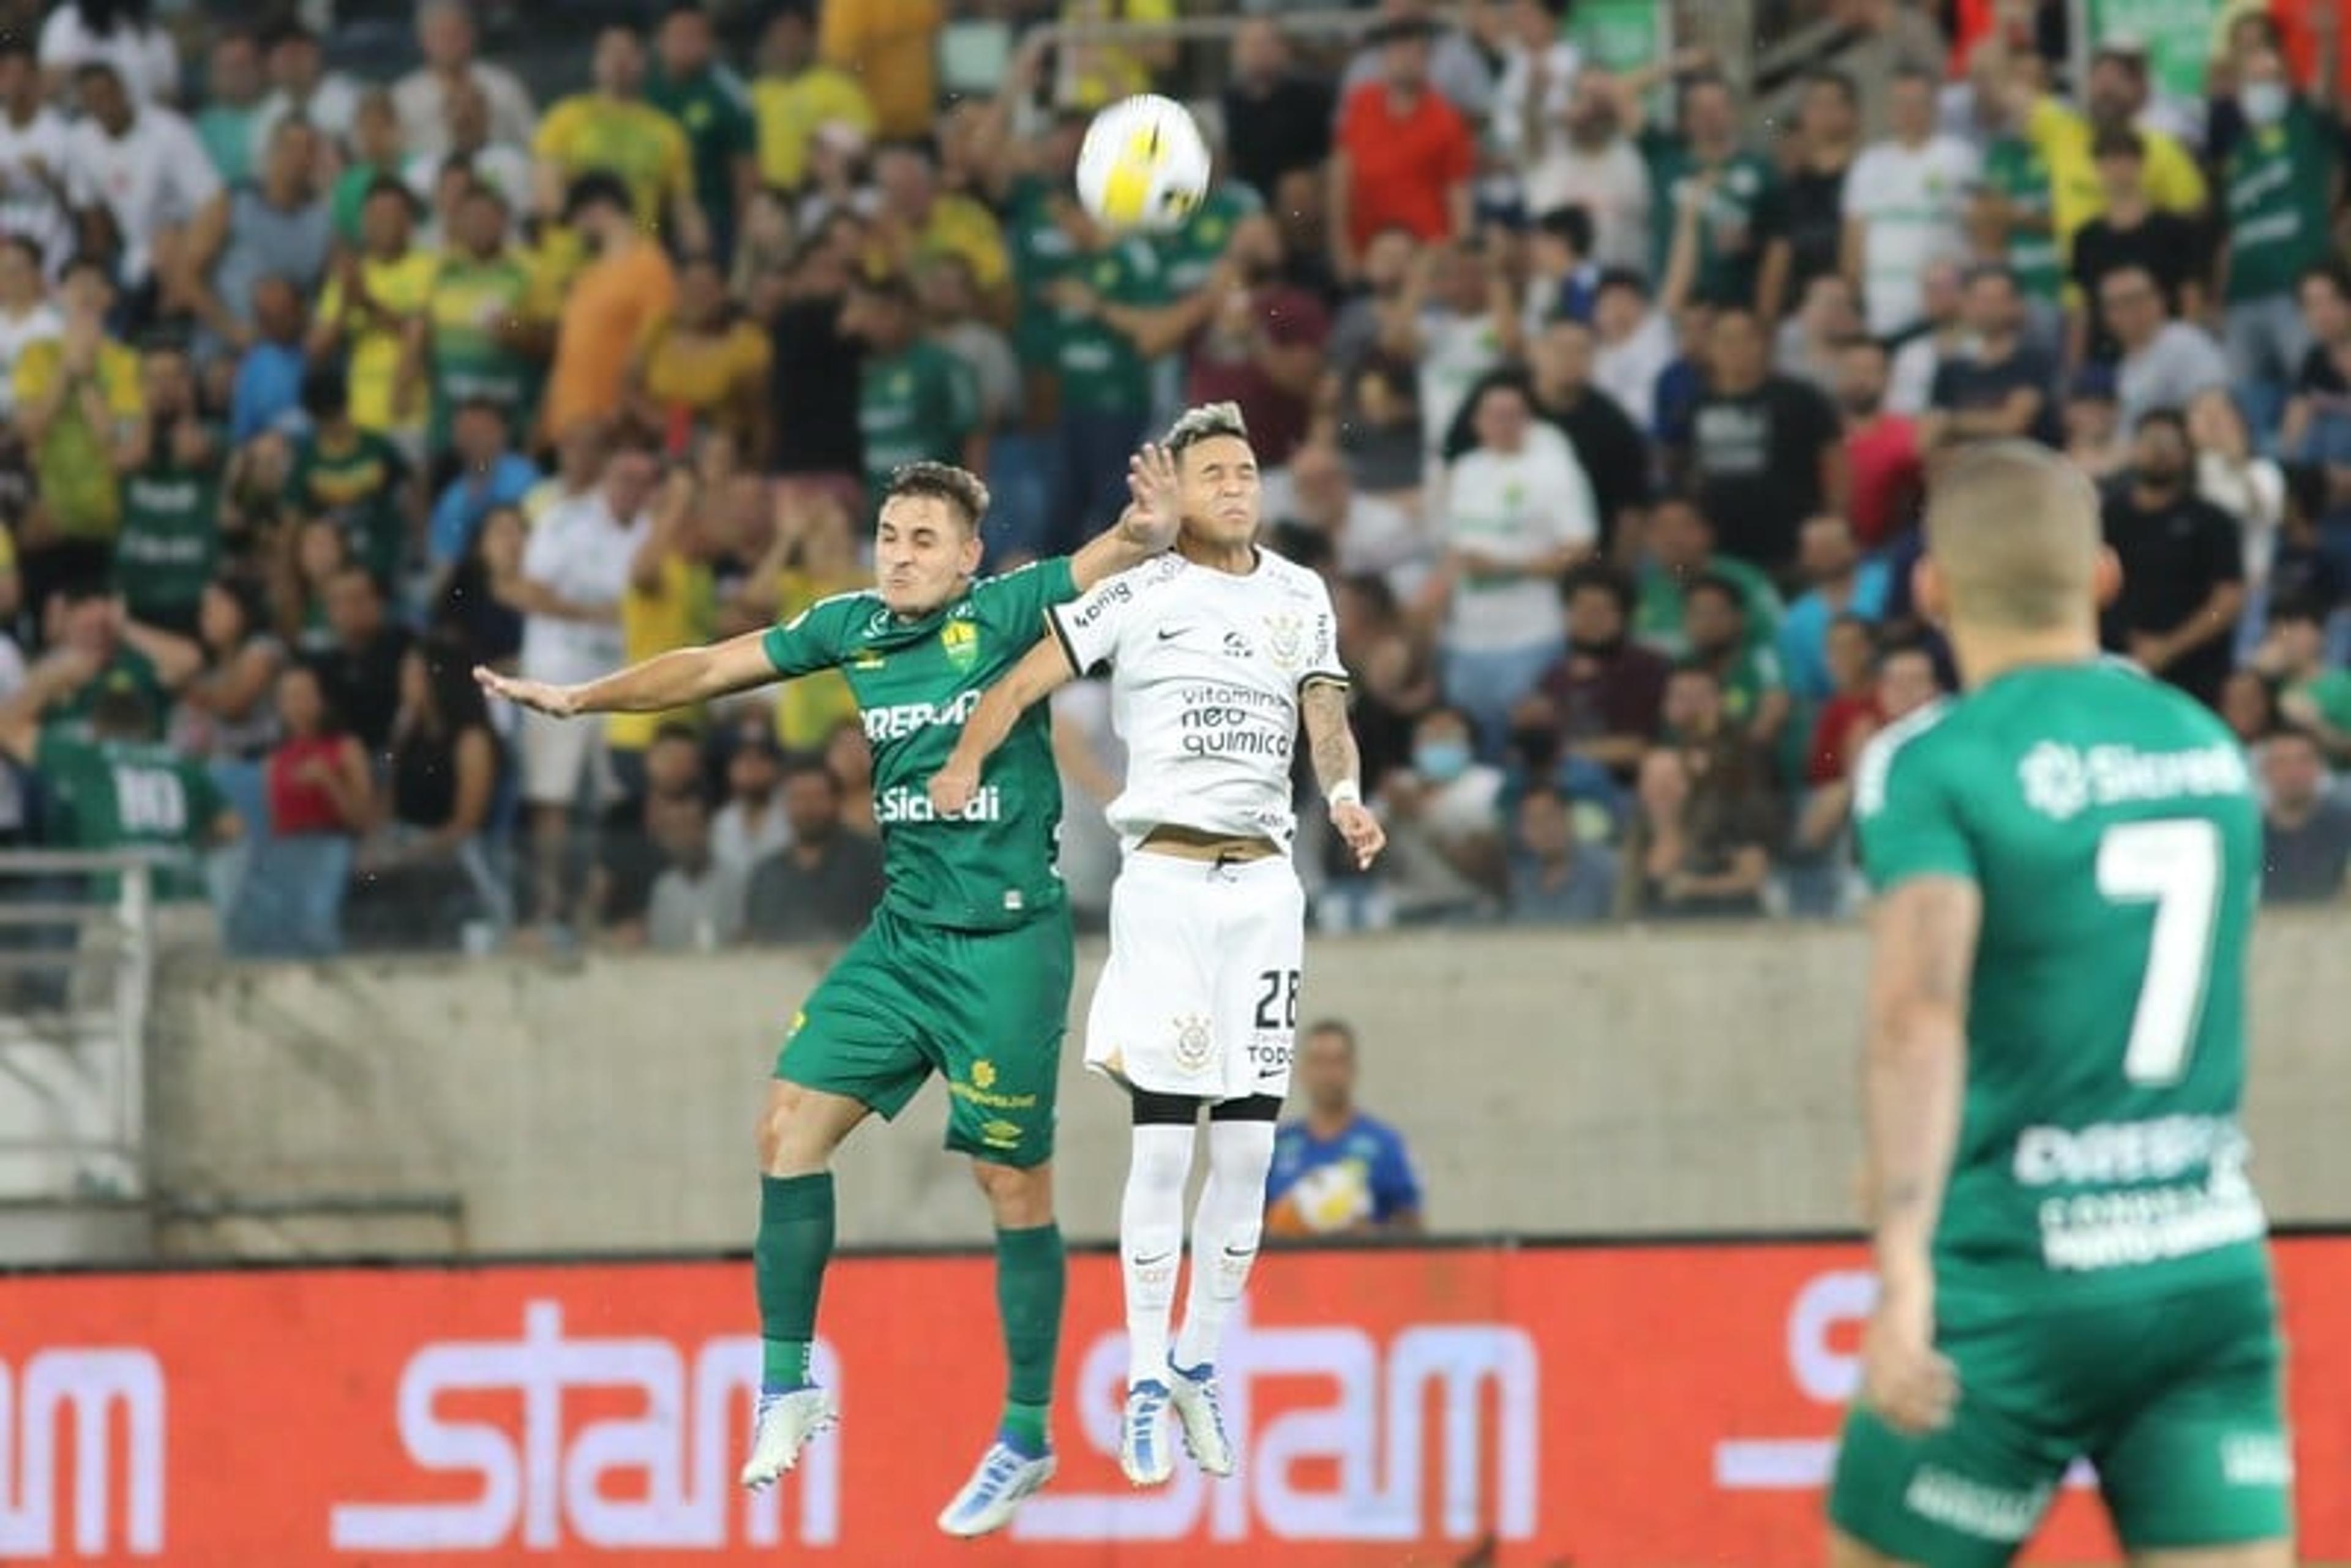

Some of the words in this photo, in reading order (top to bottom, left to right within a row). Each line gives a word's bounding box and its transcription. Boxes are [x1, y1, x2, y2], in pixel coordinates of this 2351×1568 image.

[1182, 706, 1246, 729] neo
[882, 786, 1000, 822] Sicrdi
[2097, 818, 2222, 1087] 7
[329, 1299, 839, 1552] stam
